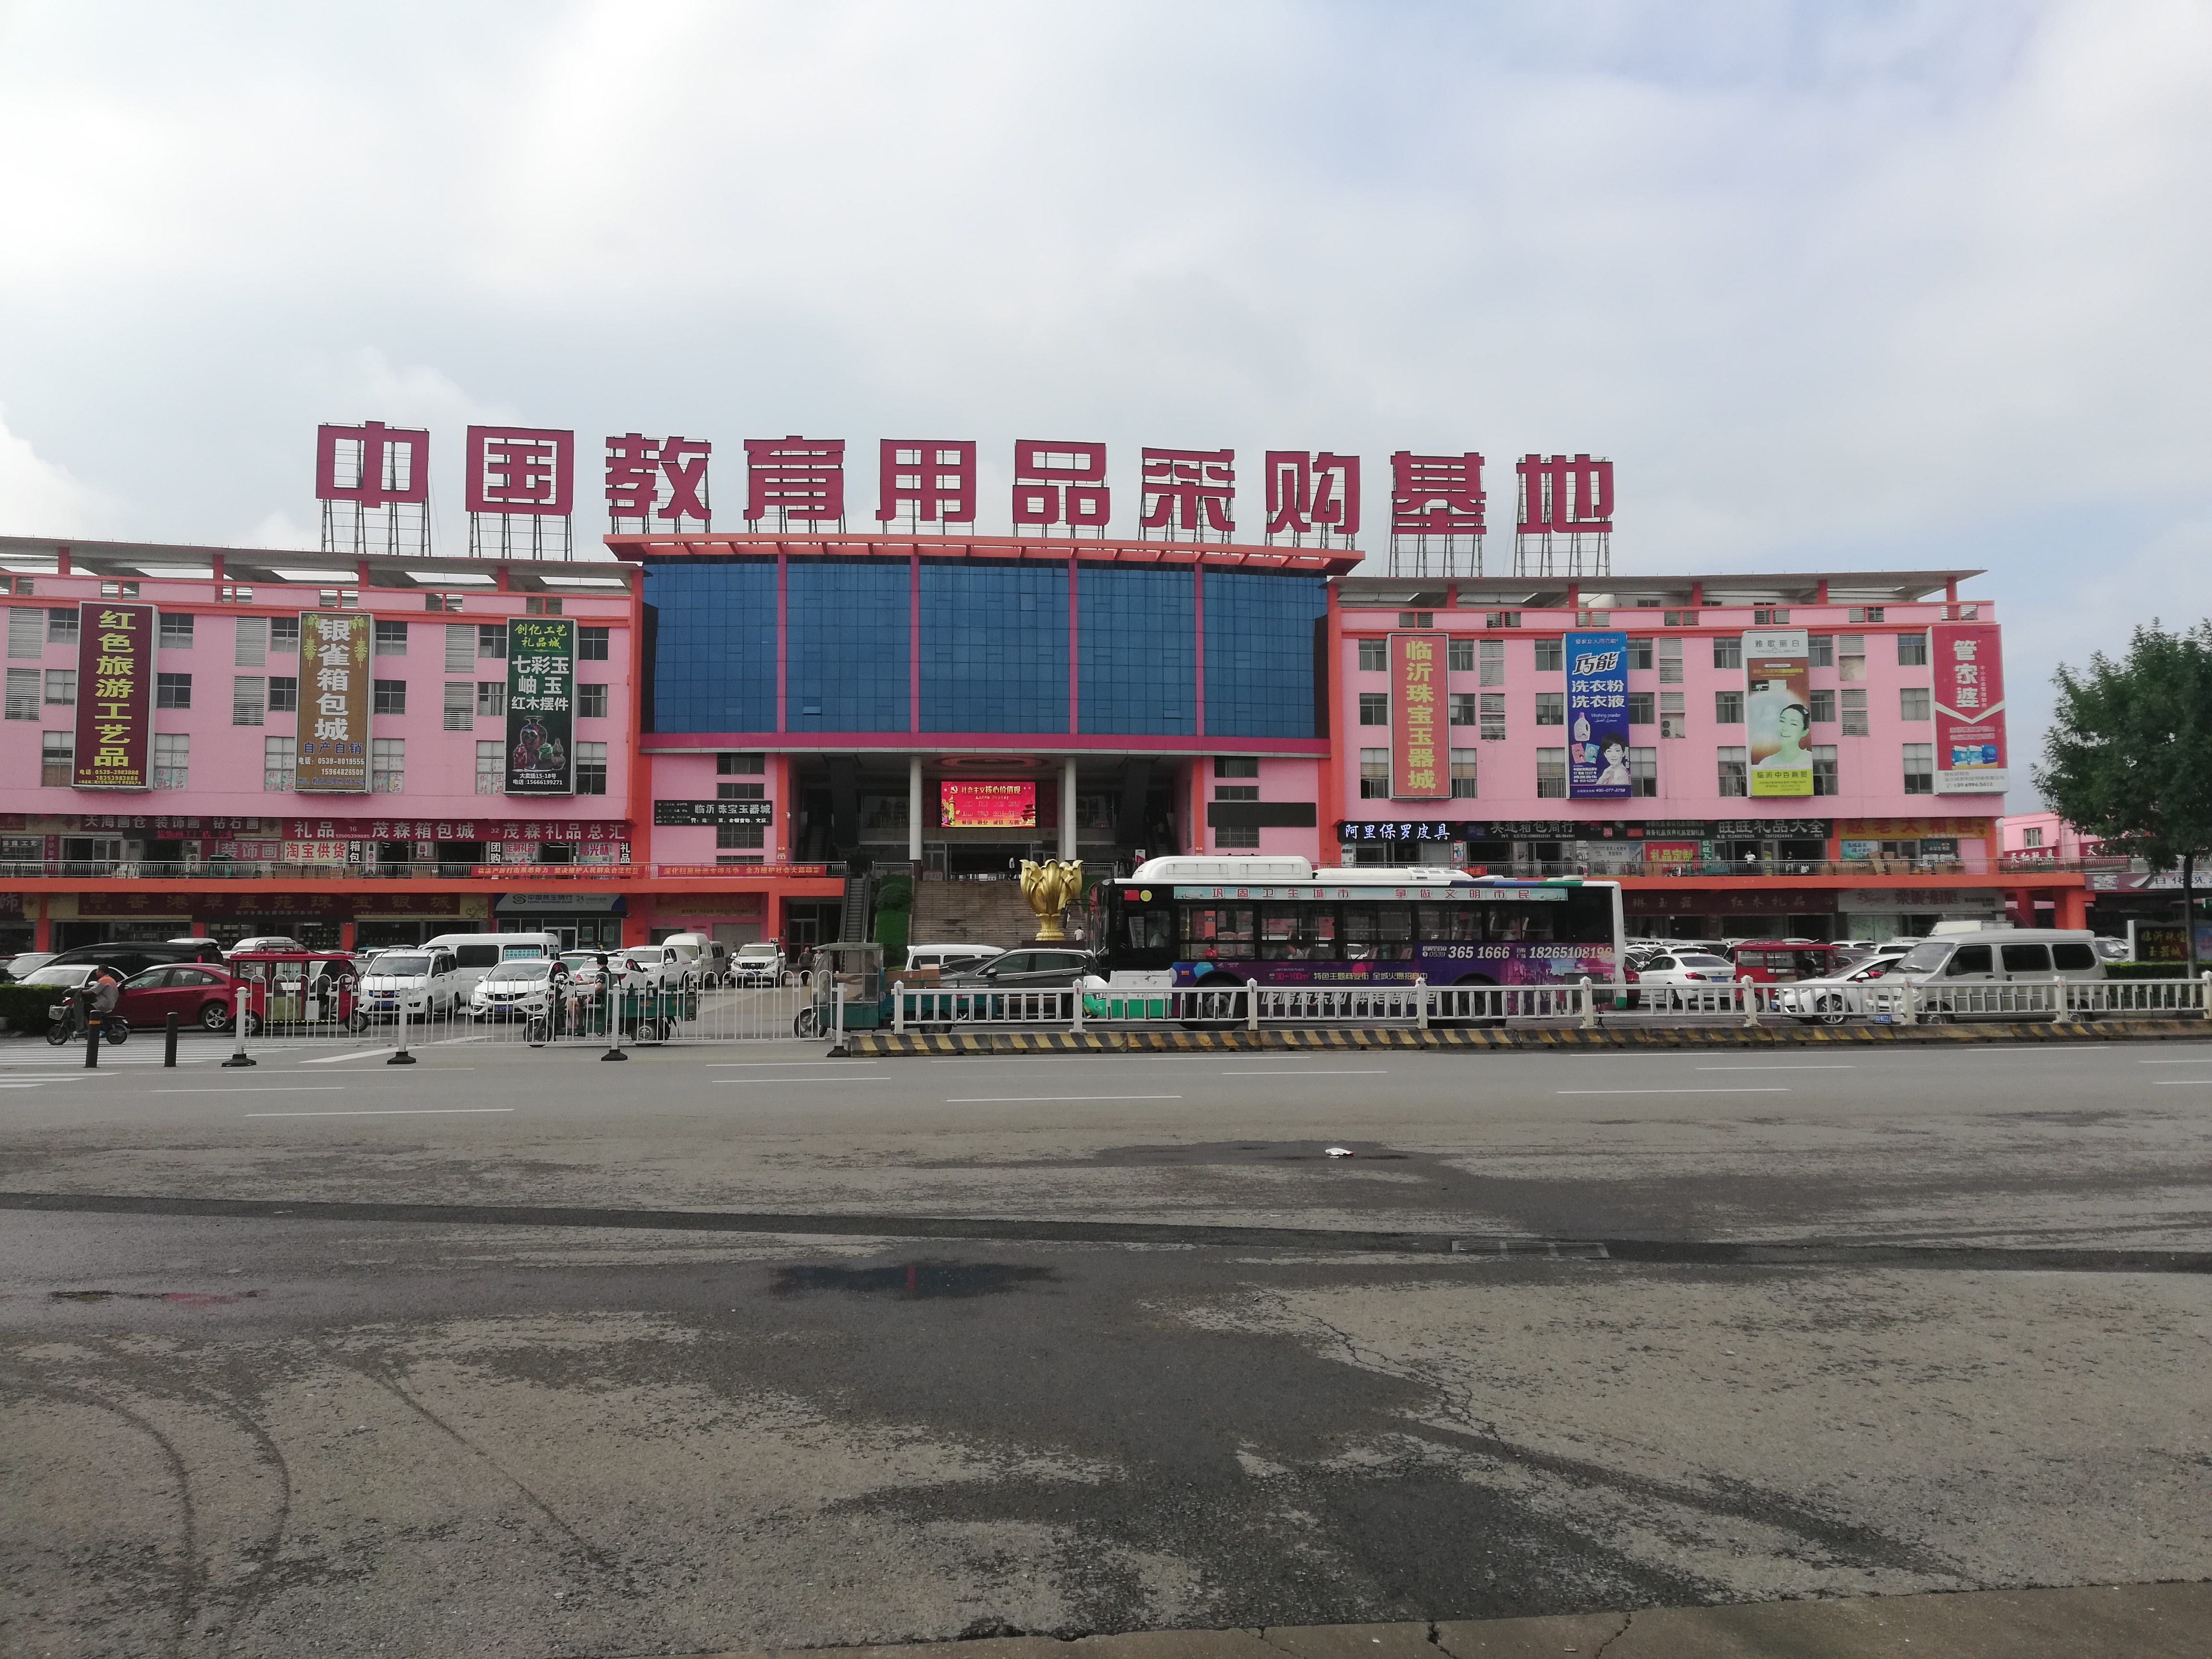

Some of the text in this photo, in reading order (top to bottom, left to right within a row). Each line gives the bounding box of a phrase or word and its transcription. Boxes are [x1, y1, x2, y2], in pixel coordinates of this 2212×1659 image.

[315, 421, 1615, 534] 中国教育用品采购基地
[515, 624, 568, 637] 创亿工艺
[522, 637, 562, 649] 礼品城
[1755, 639, 1799, 648] 雅歌丽白
[512, 655, 569, 675] 七彩玉
[1572, 651, 1621, 676] 巧能
[314, 618, 351, 742] 银雀箱包城
[1953, 640, 1980, 708] 管家婆
[95, 610, 136, 767] 红色旅游工艺品
[518, 676, 562, 695] 岫玉
[1572, 680, 1624, 693] 洗衣粉
[511, 697, 569, 711] 红木摆件
[1572, 695, 1625, 708] 洗衣液
[1406, 641, 1436, 790] 临沂珠宝玉器城
[304, 742, 362, 755] 自产自销
[962, 785, 1021, 794] 社会主义核心价值观
[155, 816, 200, 829] 装饰画
[213, 817, 259, 830] 钻石画
[294, 821, 335, 838] 礼品
[372, 821, 475, 839] 茂森箱包城
[503, 822, 625, 840] 茂森礼品总汇
[1719, 819, 1825, 833] 旺旺礼品大全
[1346, 823, 1450, 841] 阿里保罗皮具
[221, 842, 277, 858] 装饰画
[286, 842, 346, 859] 淘宝供货
[349, 841, 361, 862] 箱包
[491, 842, 501, 863] 团购
[620, 842, 630, 863] 礼品
[1650, 849, 1694, 862] 礼品定制
[1212, 887, 1531, 900] 巩固卫生城市 争做文明市民
[1448, 946, 1473, 959] 365
[1477, 946, 1510, 959] 1666
[1529, 946, 1613, 959] 18265108198
